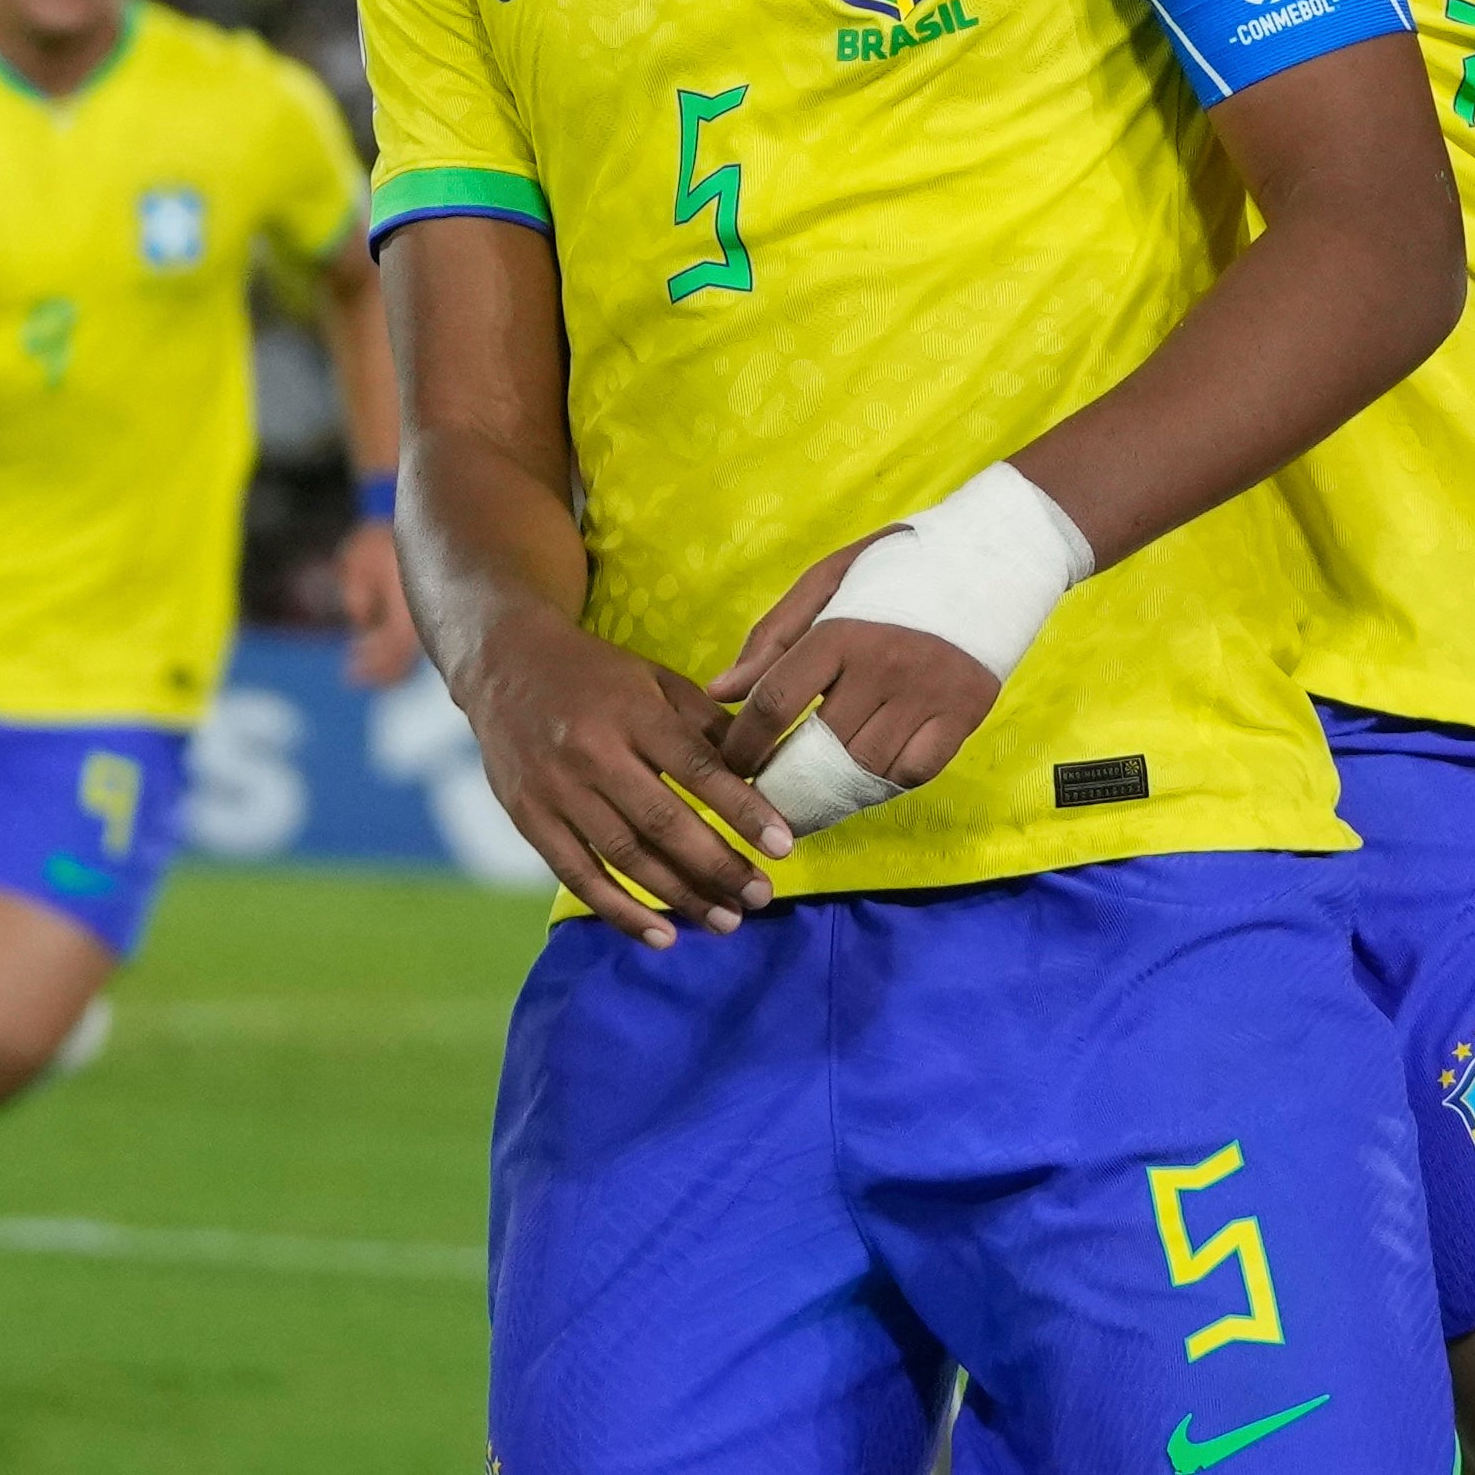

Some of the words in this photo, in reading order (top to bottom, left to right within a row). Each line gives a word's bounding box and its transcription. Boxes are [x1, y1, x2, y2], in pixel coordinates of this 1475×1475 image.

[667, 84, 750, 304] 5
[81, 750, 142, 857] 9
[1146, 1138, 1286, 1363] 5
